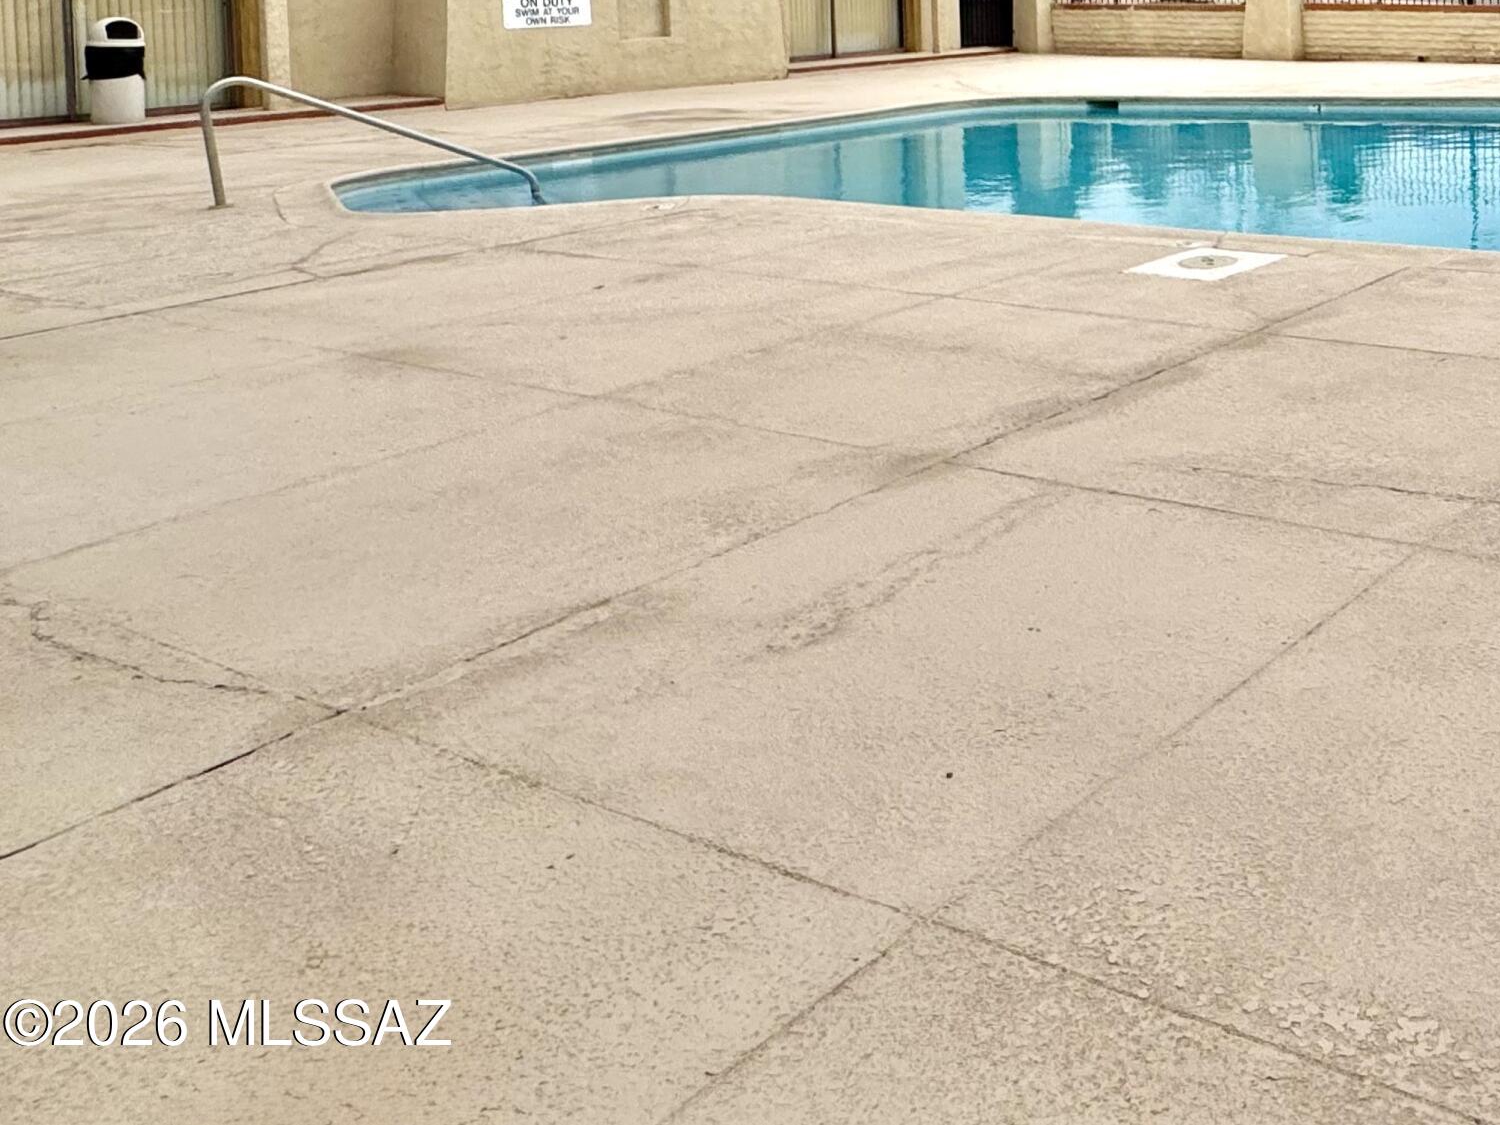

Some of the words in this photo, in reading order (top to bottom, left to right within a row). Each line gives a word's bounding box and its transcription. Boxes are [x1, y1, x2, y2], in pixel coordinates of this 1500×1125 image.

[515, 8, 539, 17] SWIM
[543, 8, 552, 16] AT
[557, 6, 579, 16] YOUR
[526, 17, 547, 25] OWN
[550, 16, 570, 24] RISK
